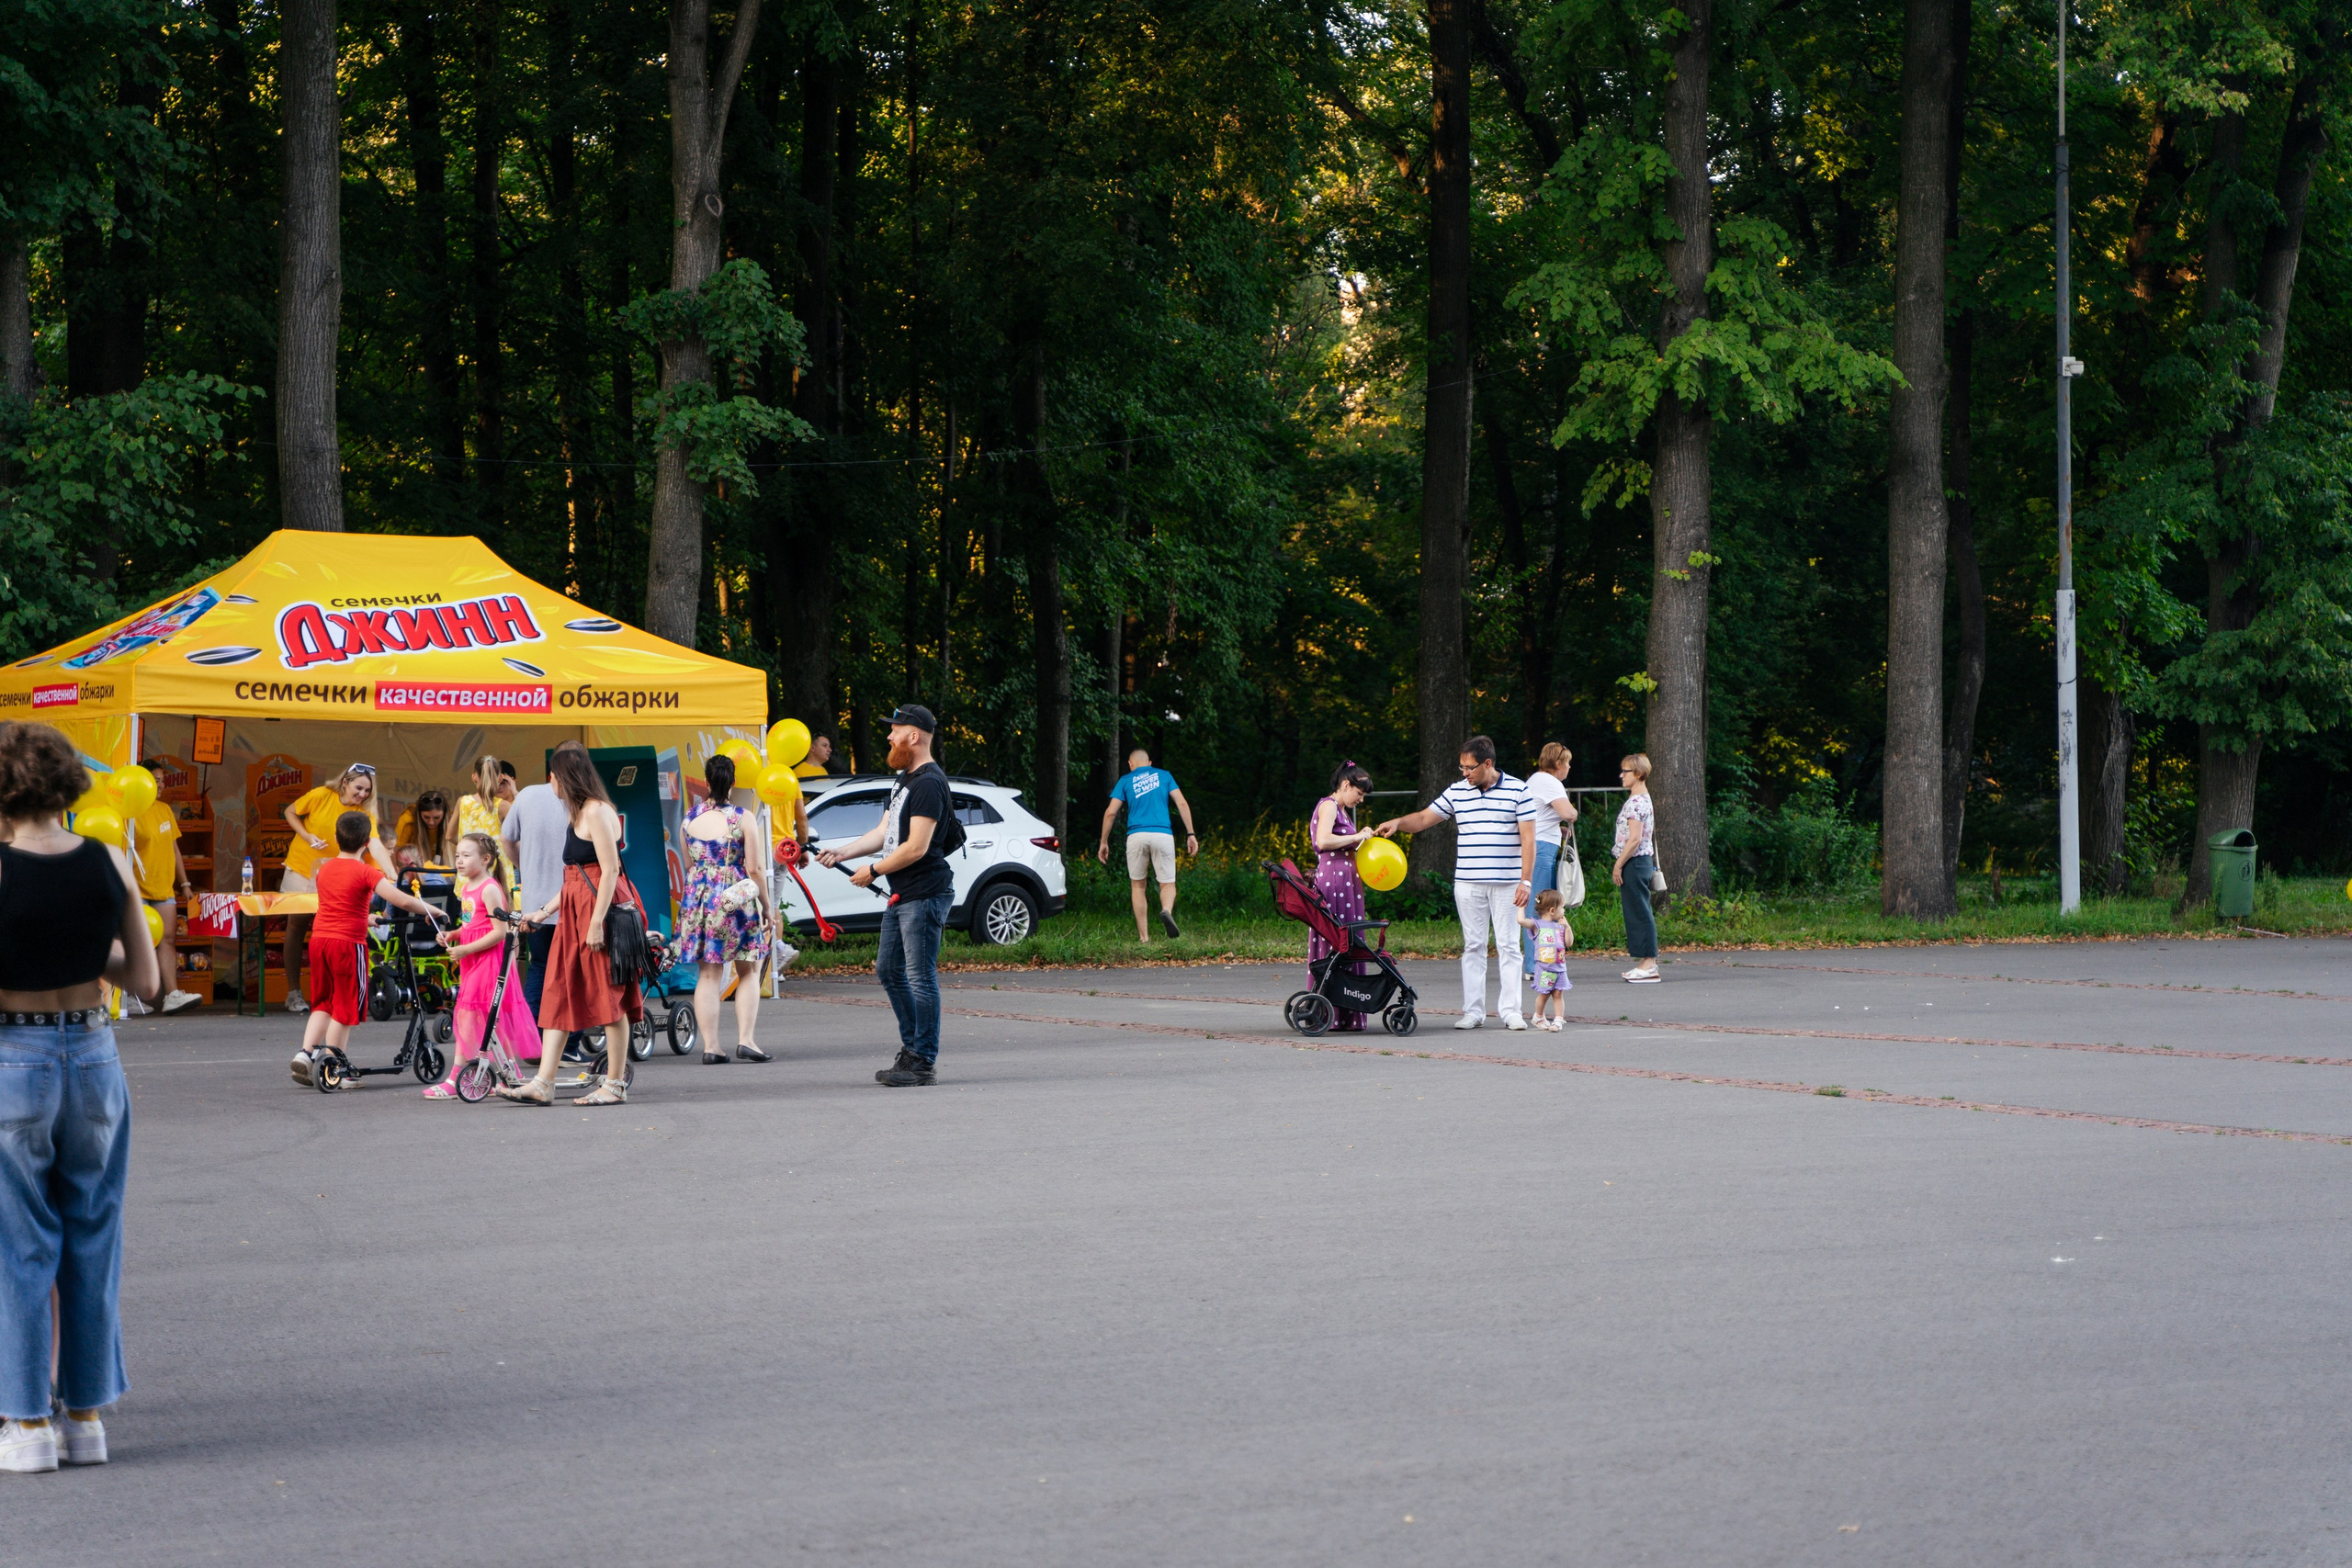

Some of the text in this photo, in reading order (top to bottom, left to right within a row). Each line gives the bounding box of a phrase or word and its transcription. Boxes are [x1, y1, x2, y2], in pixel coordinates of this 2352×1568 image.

[330, 592, 442, 607] семечки
[33, 685, 77, 705] качественной
[79, 682, 115, 703] обжарки
[235, 681, 679, 714] семечки качественной обжарки
[1133, 775, 1159, 790] POWER
[1141, 781, 1159, 792] WIN
[1344, 987, 1372, 1002] Indigo
